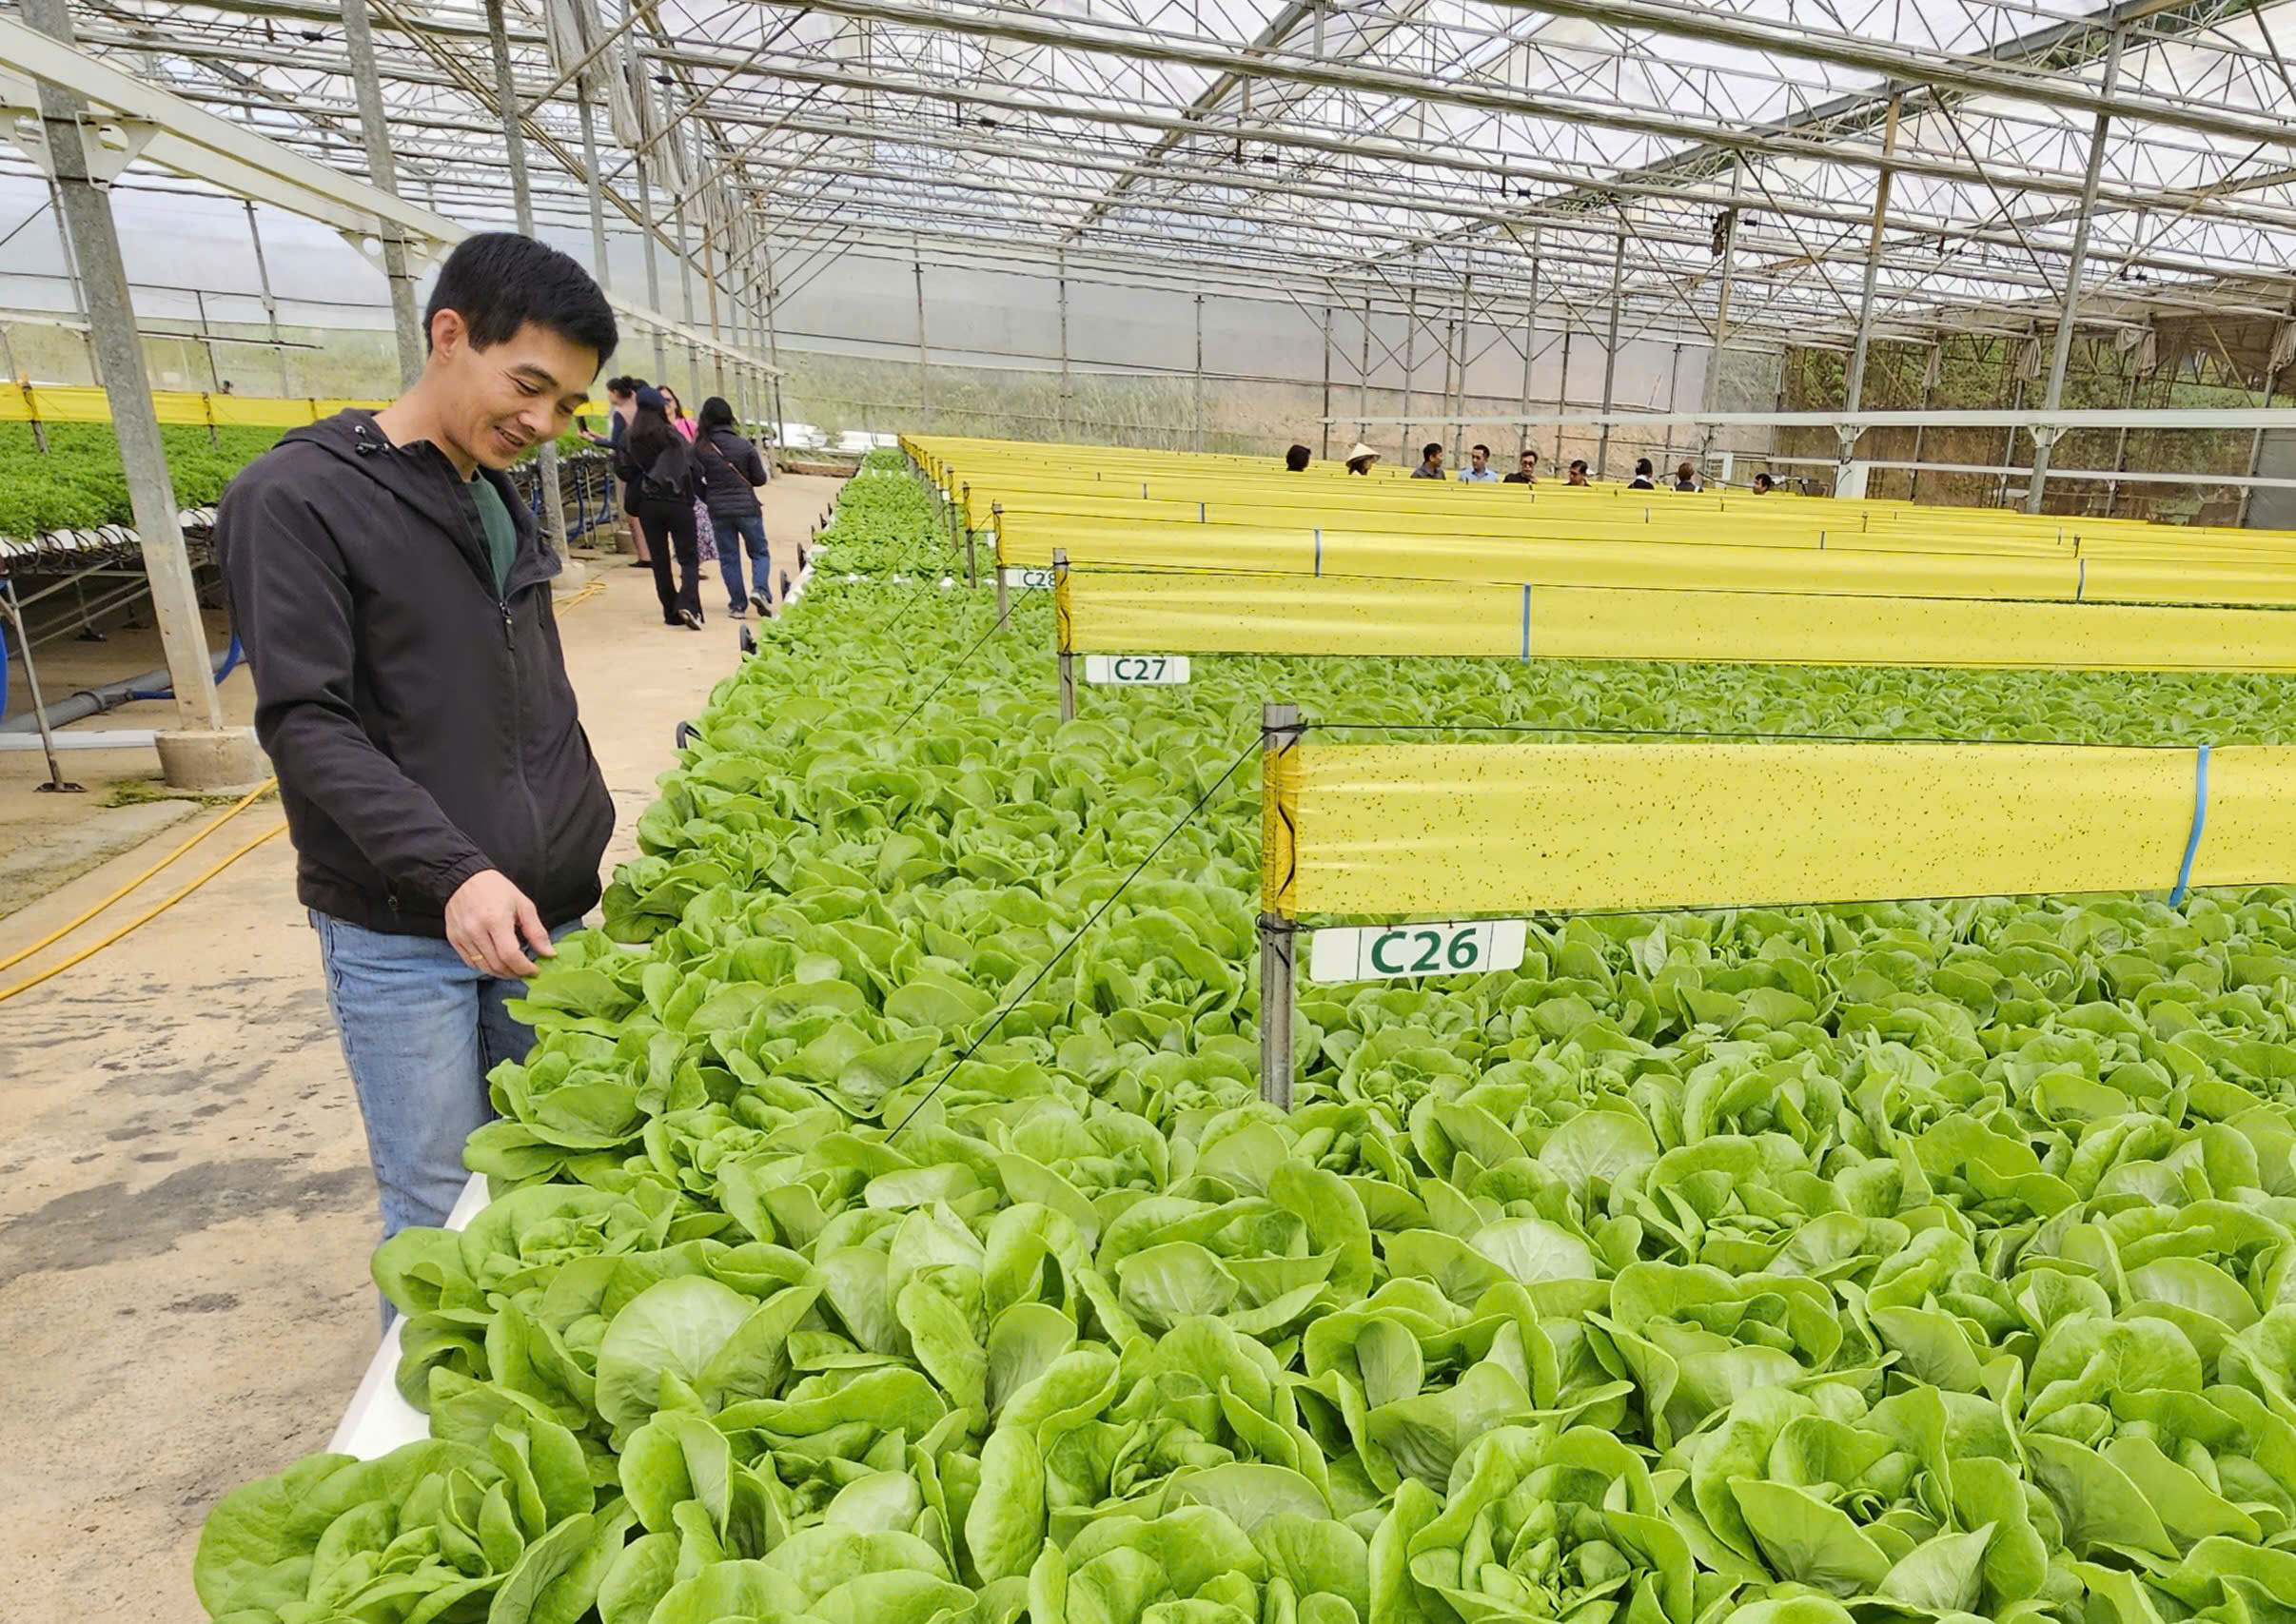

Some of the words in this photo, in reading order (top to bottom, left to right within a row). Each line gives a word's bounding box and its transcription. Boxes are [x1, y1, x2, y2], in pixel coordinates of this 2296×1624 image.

[1023, 572, 1055, 587] C28
[1114, 658, 1167, 680] C27
[1371, 928, 1479, 973] C26
